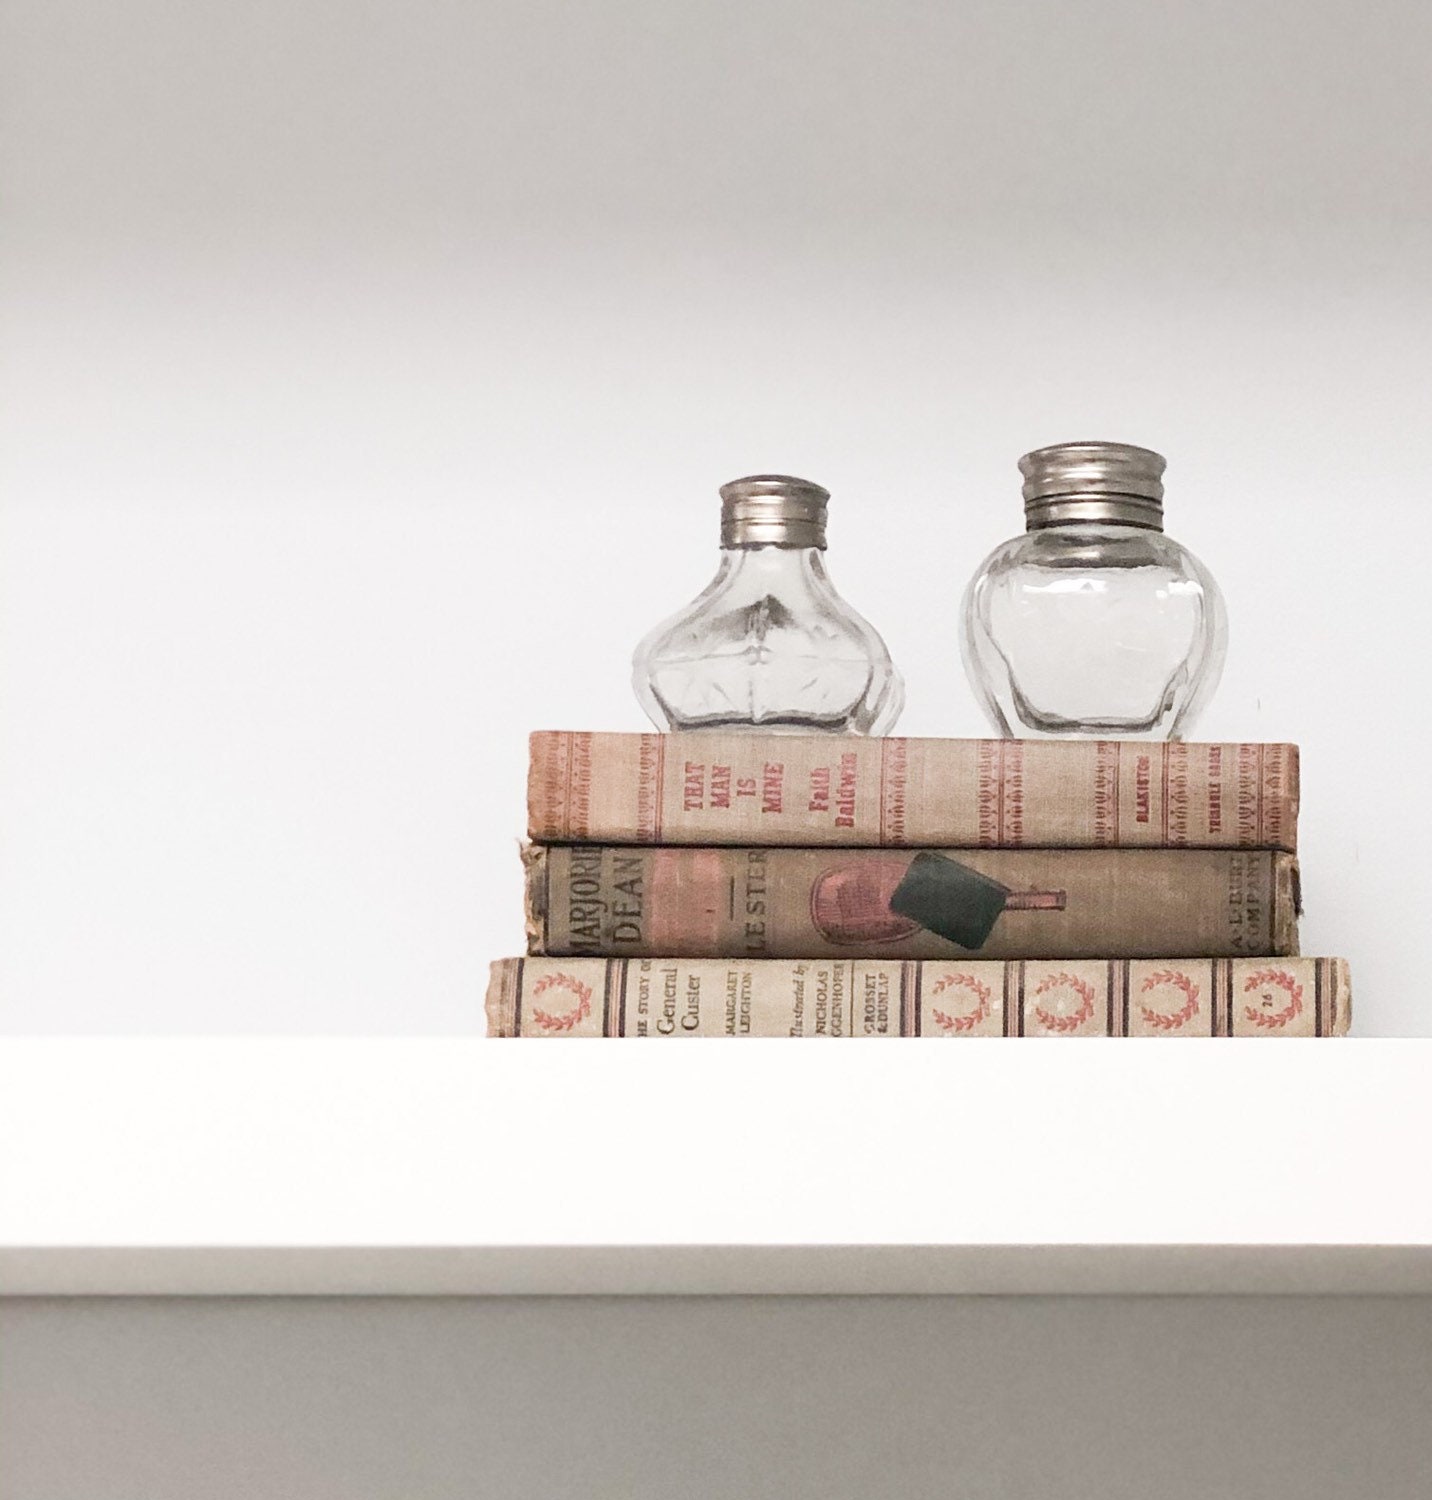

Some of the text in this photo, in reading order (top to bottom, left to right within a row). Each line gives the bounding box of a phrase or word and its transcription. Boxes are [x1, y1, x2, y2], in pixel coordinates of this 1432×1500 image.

[683, 761, 705, 812] THAT
[710, 765, 732, 809] MAN
[736, 778, 757, 797] IS
[761, 761, 784, 814] MINE
[807, 767, 830, 812] Faith
[834, 752, 858, 828] Baldwin
[612, 856, 643, 944] DEAN
[638, 976, 650, 1015] STORY
[656, 968, 678, 1035] General
[680, 974, 701, 1031] Custer
[725, 969, 738, 1036] MARGARET
[740, 971, 753, 1034] LEIGHTON
[815, 970, 829, 1035] NICHOLAS
[863, 973, 876, 1034] GROSSET
[637, 1019, 648, 1038] HE
